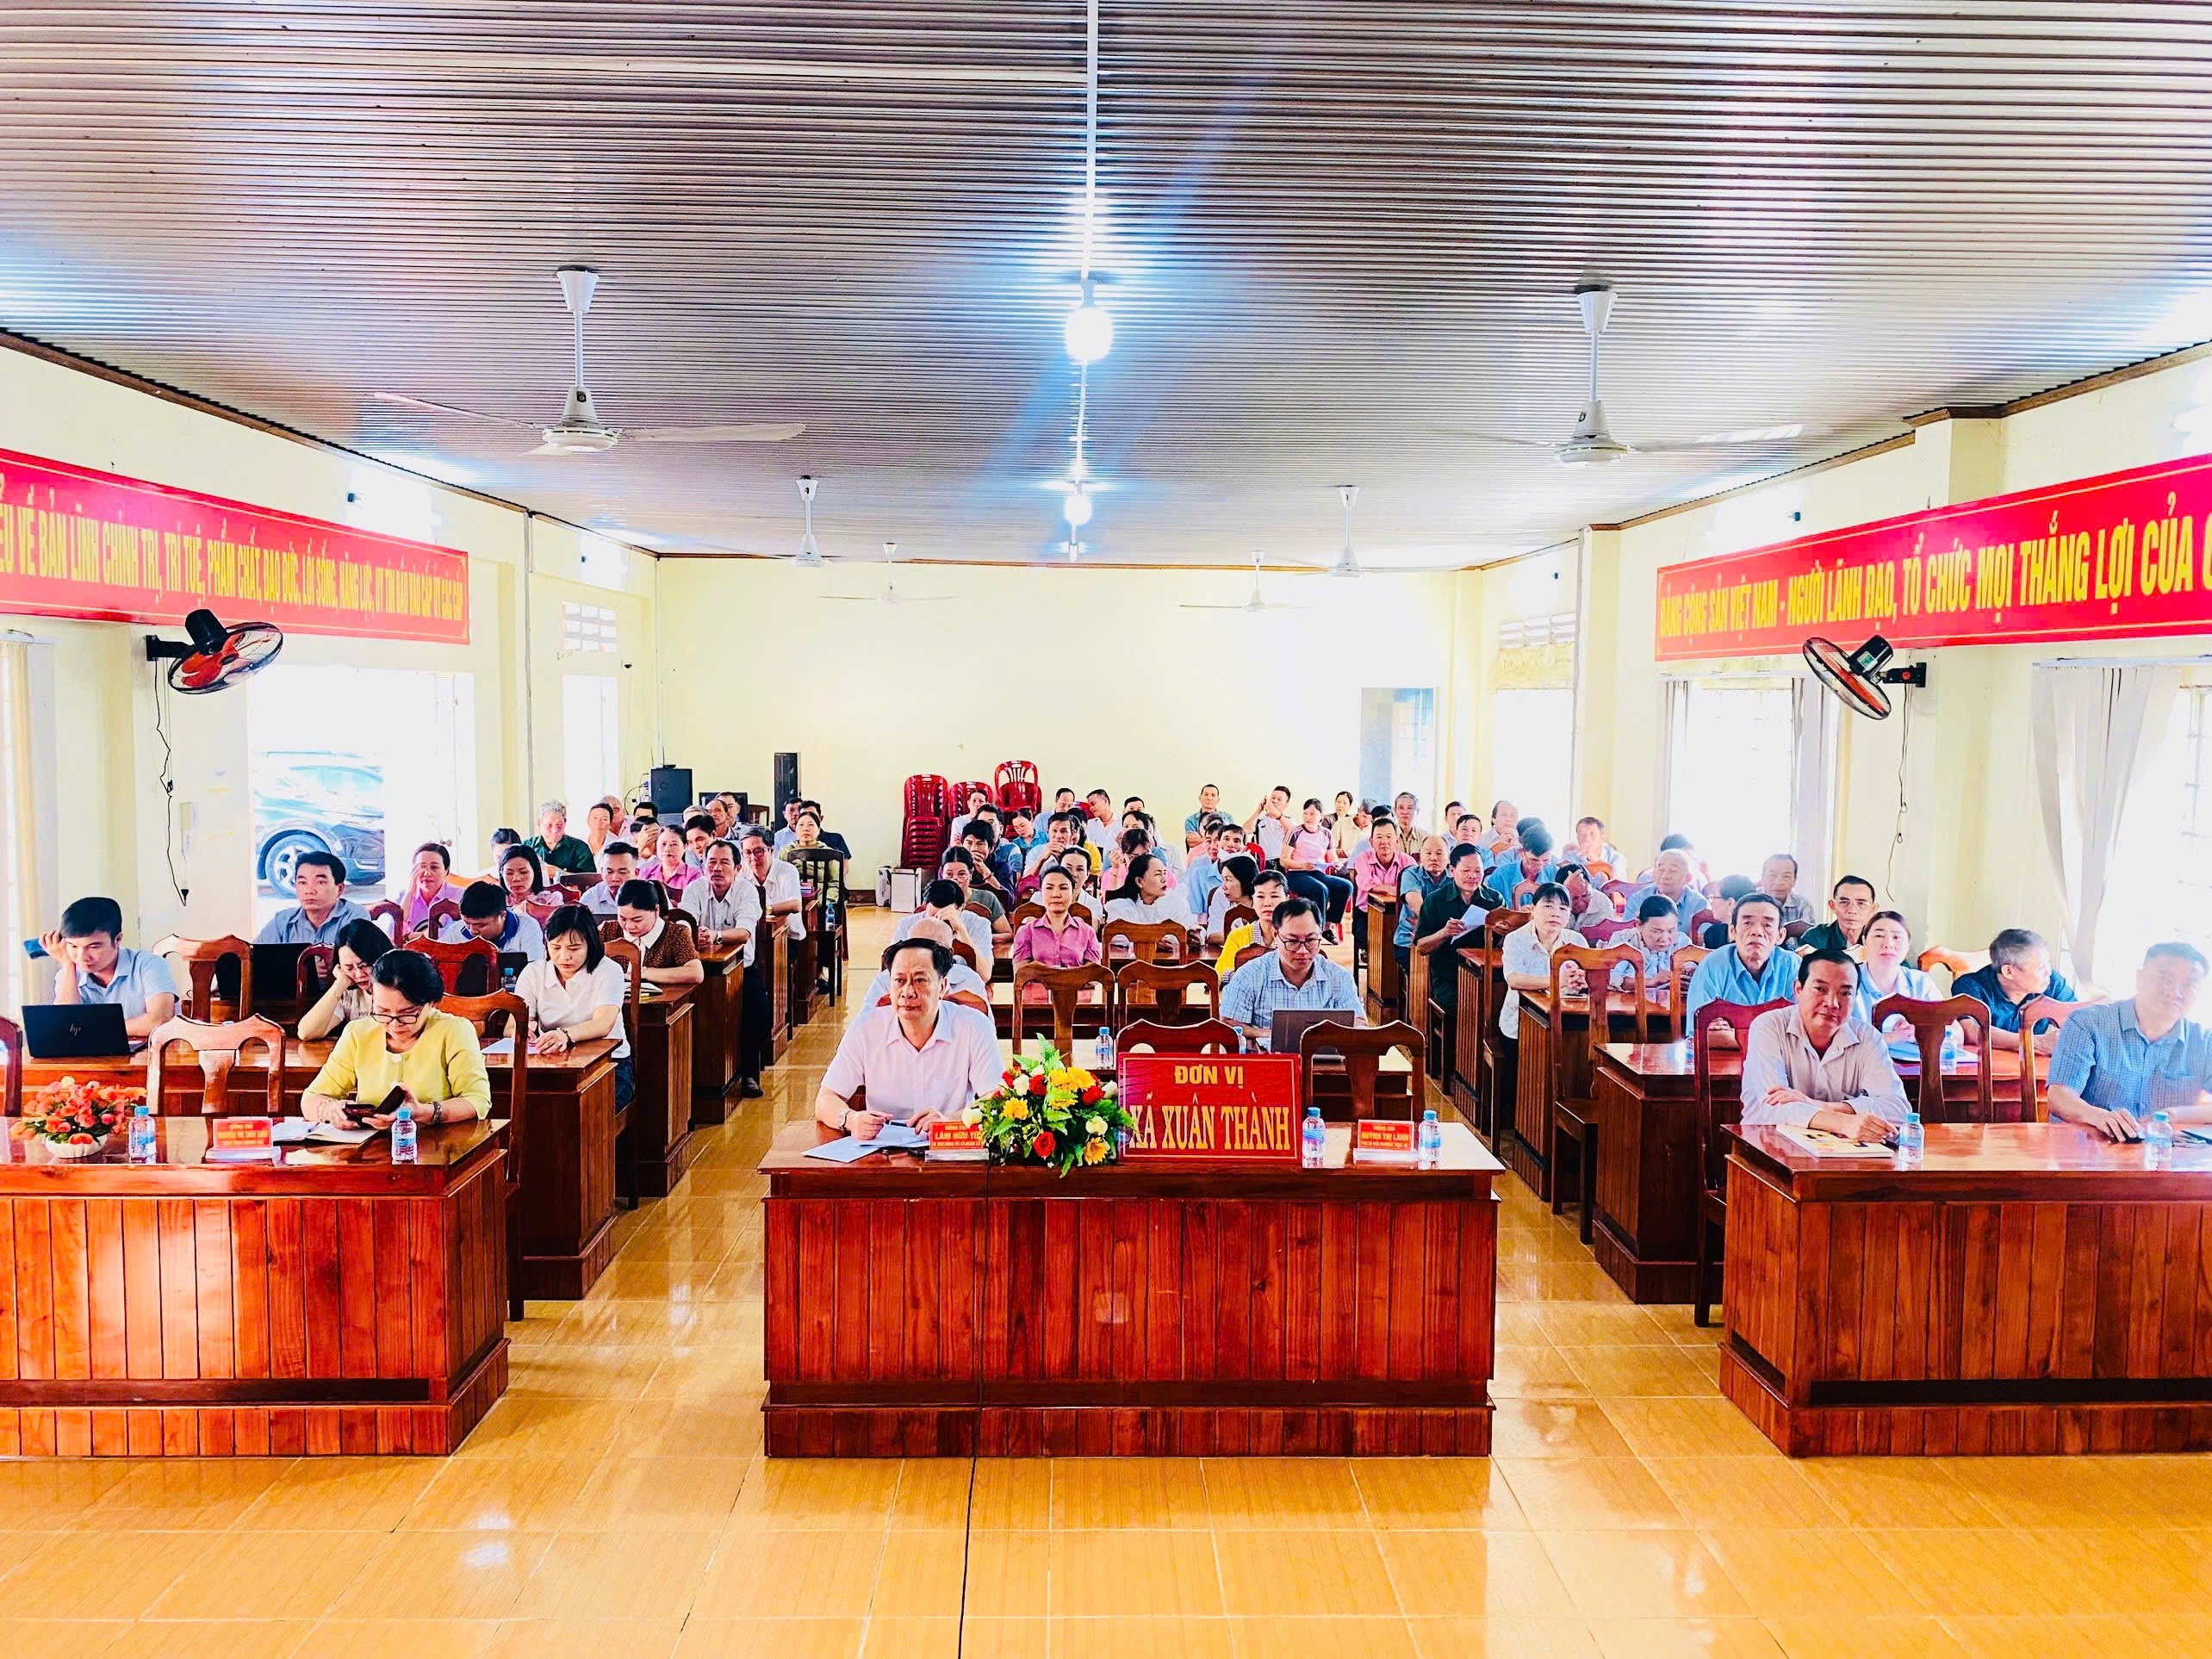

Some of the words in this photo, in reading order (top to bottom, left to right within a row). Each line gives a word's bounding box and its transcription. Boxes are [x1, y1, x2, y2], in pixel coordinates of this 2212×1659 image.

[17, 484, 35, 575] VỀ
[38, 488, 67, 580] BẢN
[103, 510, 139, 587] CHÍNH
[140, 528, 162, 605] TRỊ,
[165, 520, 181, 593] TRÍ
[183, 524, 206, 606] TUỆ,
[207, 518, 235, 597] PHẨM
[238, 526, 262, 606] CHẤT,
[263, 549, 280, 614] ĐẠO
[1660, 582, 1682, 637] ĐẢNG
[1683, 583, 1707, 645] CỘNG
[1709, 573, 1728, 633] SẢN
[1730, 575, 1751, 641] VIỆT
[1753, 579, 1779, 628] NAM
[1787, 560, 1824, 625] NGƯỜI
[1865, 561, 1898, 631] ĐẠO,
[1903, 531, 1922, 615] TỔ
[1925, 537, 1972, 613] CHỨC
[1976, 543, 2015, 624] MỌI
[2020, 510, 2091, 606] THẮNG
[2095, 518, 2135, 615] LỢI
[2141, 491, 2193, 596] CỦA
[1129, 1091, 1158, 1149] XÃ
[1161, 1092, 1215, 1150] XUÂN
[1221, 1091, 1290, 1150] THÀNH
[1174, 1064, 1218, 1084] ĐƠN
[1224, 1066, 1244, 1090] VỊ
